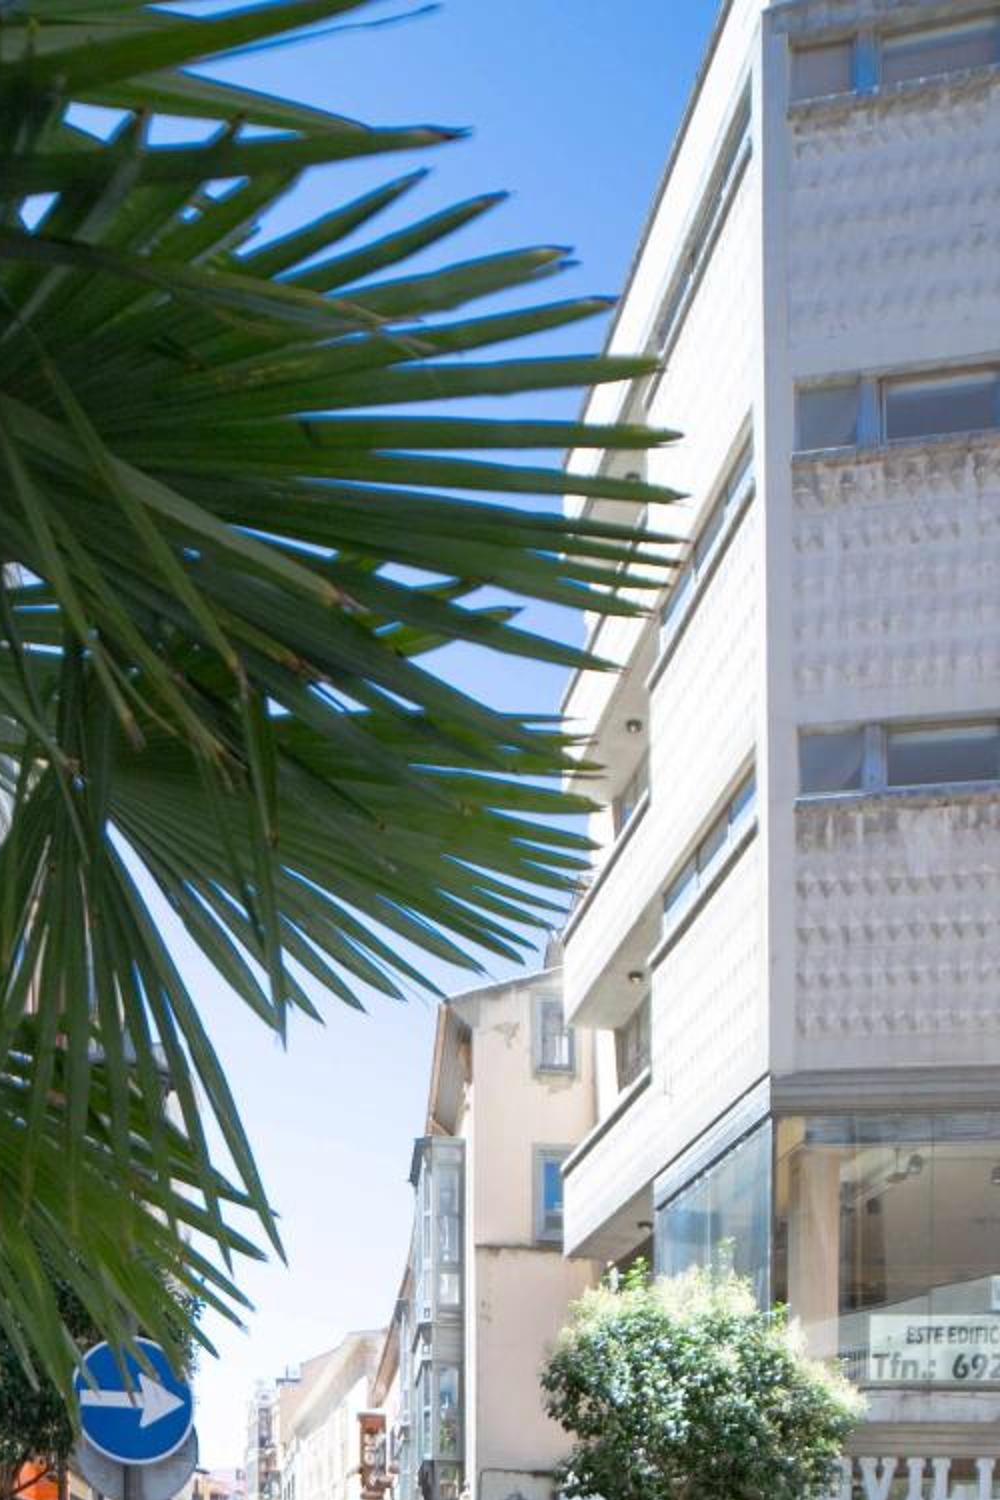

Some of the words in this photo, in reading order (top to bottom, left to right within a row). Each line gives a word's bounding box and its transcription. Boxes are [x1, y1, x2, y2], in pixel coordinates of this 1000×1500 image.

[906, 1326, 944, 1344] ESTE
[872, 1351, 936, 1379] Tfn.:
[952, 1352, 1000, 1379] 692
